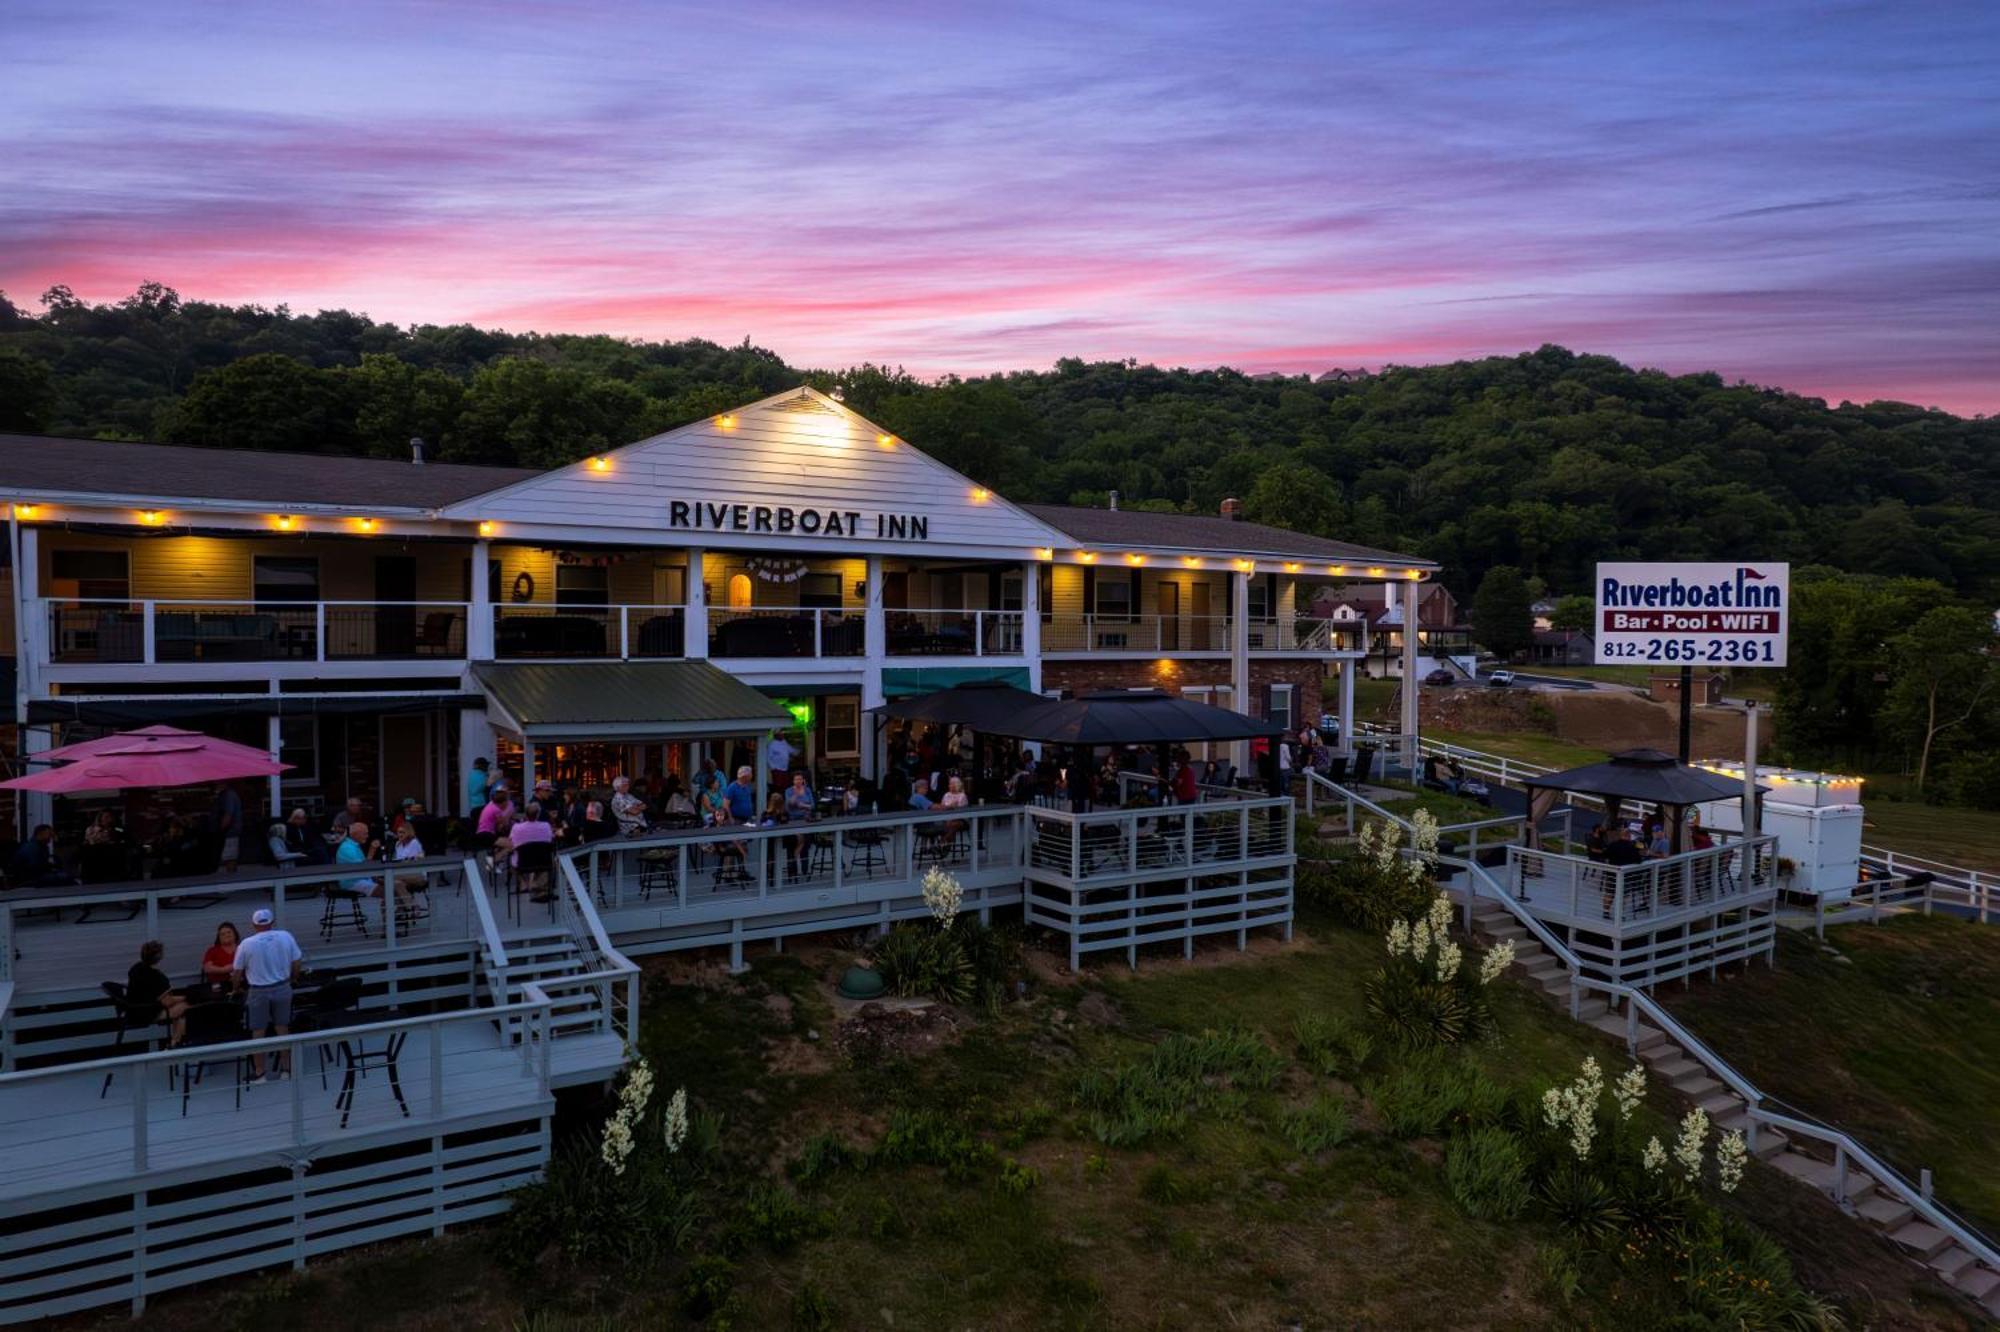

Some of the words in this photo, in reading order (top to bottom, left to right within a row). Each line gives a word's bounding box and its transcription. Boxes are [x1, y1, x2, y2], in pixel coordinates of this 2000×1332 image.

[670, 500, 860, 536] RIVERBOAT
[877, 513, 928, 539] INN
[1603, 577, 1733, 607] Riverboat
[1736, 567, 1781, 607] Inn
[1614, 613, 1650, 629] Bar
[1663, 614, 1708, 630] Pool
[1603, 639, 1774, 662] 812-265-2361
